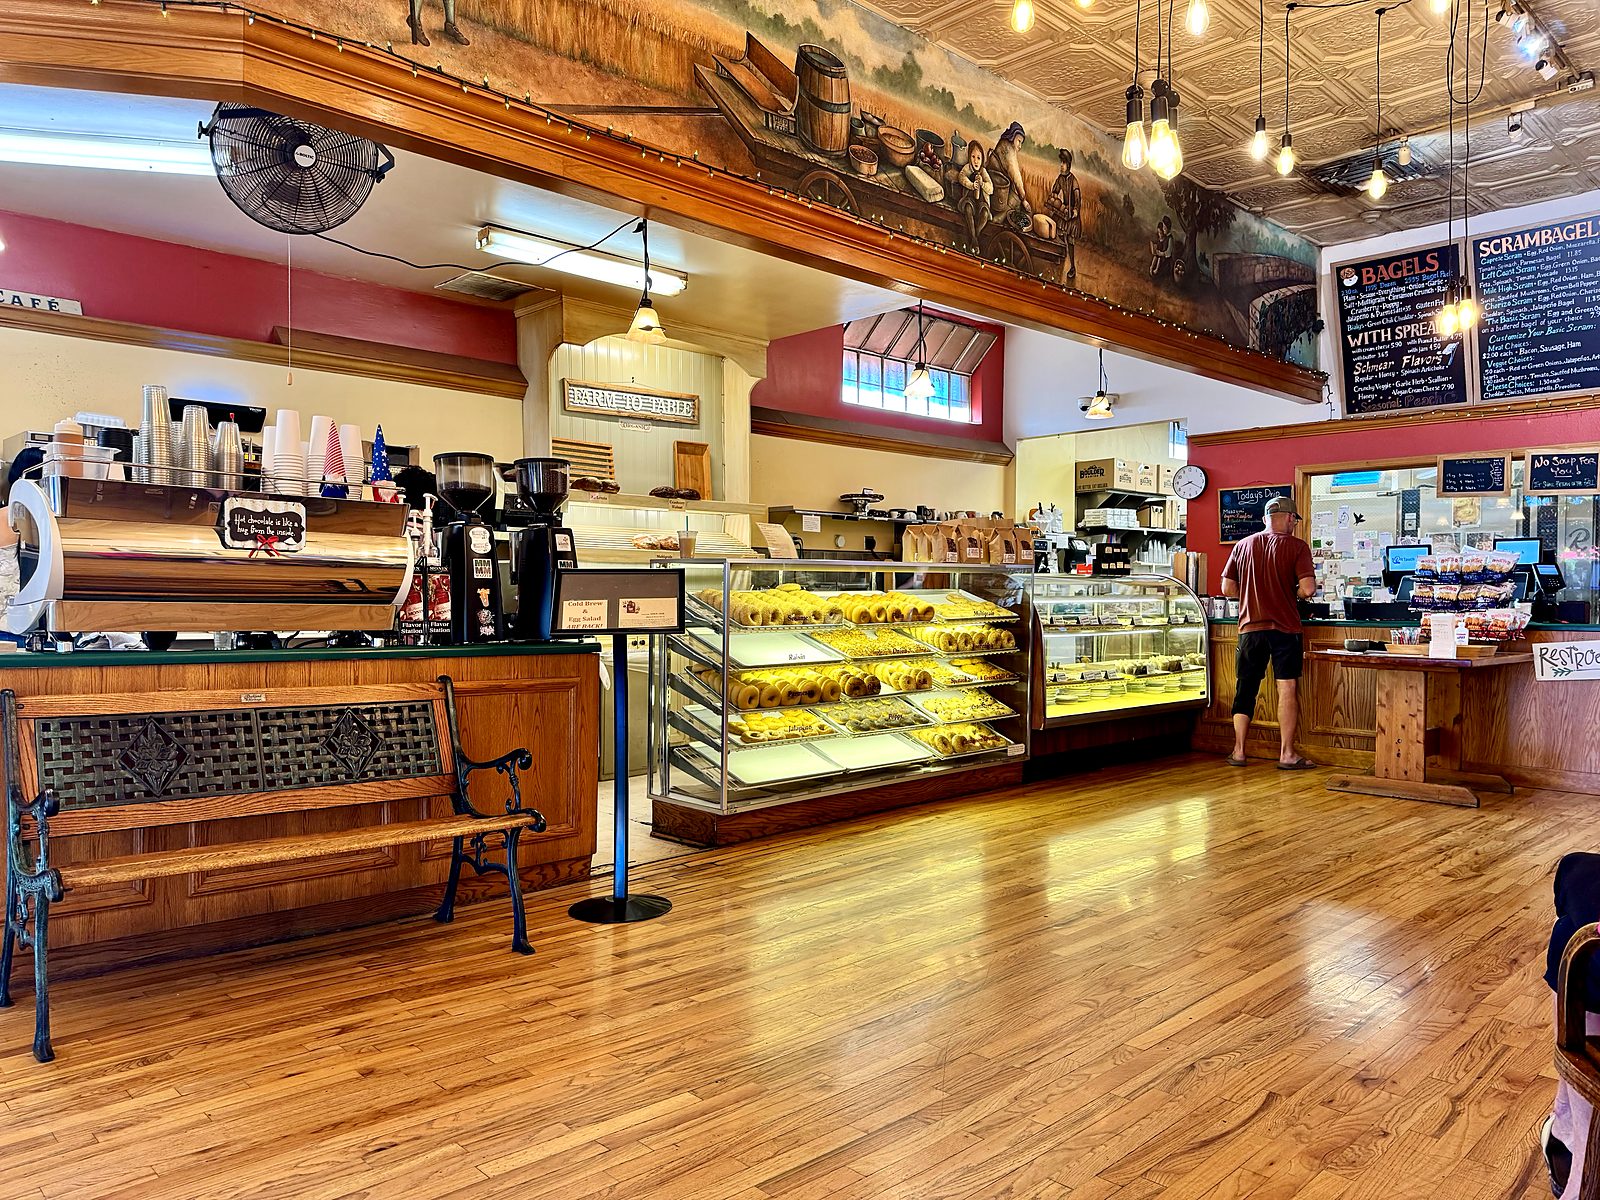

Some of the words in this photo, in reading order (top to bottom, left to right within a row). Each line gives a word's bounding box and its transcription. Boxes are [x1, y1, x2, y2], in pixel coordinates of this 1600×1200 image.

[1479, 220, 1600, 258] SCRAMBAGEL
[1503, 253, 1523, 261] Scram
[1546, 252, 1561, 261] Bagel
[1362, 253, 1440, 285] BAGELS
[1515, 264, 1537, 274] Scram
[1513, 281, 1534, 291] Scram
[1512, 297, 1533, 307] Scram
[1500, 313, 1519, 324] Basic
[1519, 311, 1541, 321] Scram
[1561, 307, 1573, 315] and
[1347, 328, 1392, 347] WITH
[1395, 320, 1442, 340] SPREA
[1488, 332, 1527, 344] Customize
[1527, 327, 1545, 338] Your
[1544, 325, 1565, 337] Basic
[1566, 323, 1597, 333] Scram:
[1487, 343, 1504, 353] Meat
[1566, 340, 1582, 349] Ham
[1353, 361, 1395, 375] Schmear
[1402, 354, 1443, 368] Flavors
[574, 388, 617, 408] FARM
[623, 394, 643, 413] TO
[651, 397, 693, 417] TABLE
[1534, 456, 1550, 469] No
[1552, 456, 1577, 466] Soup
[1080, 468, 1105, 479] BOULDER
[234, 514, 246, 525] Hot
[282, 517, 293, 527] like
[237, 524, 249, 536] hug
[250, 525, 265, 534] from
[266, 526, 275, 535] the
